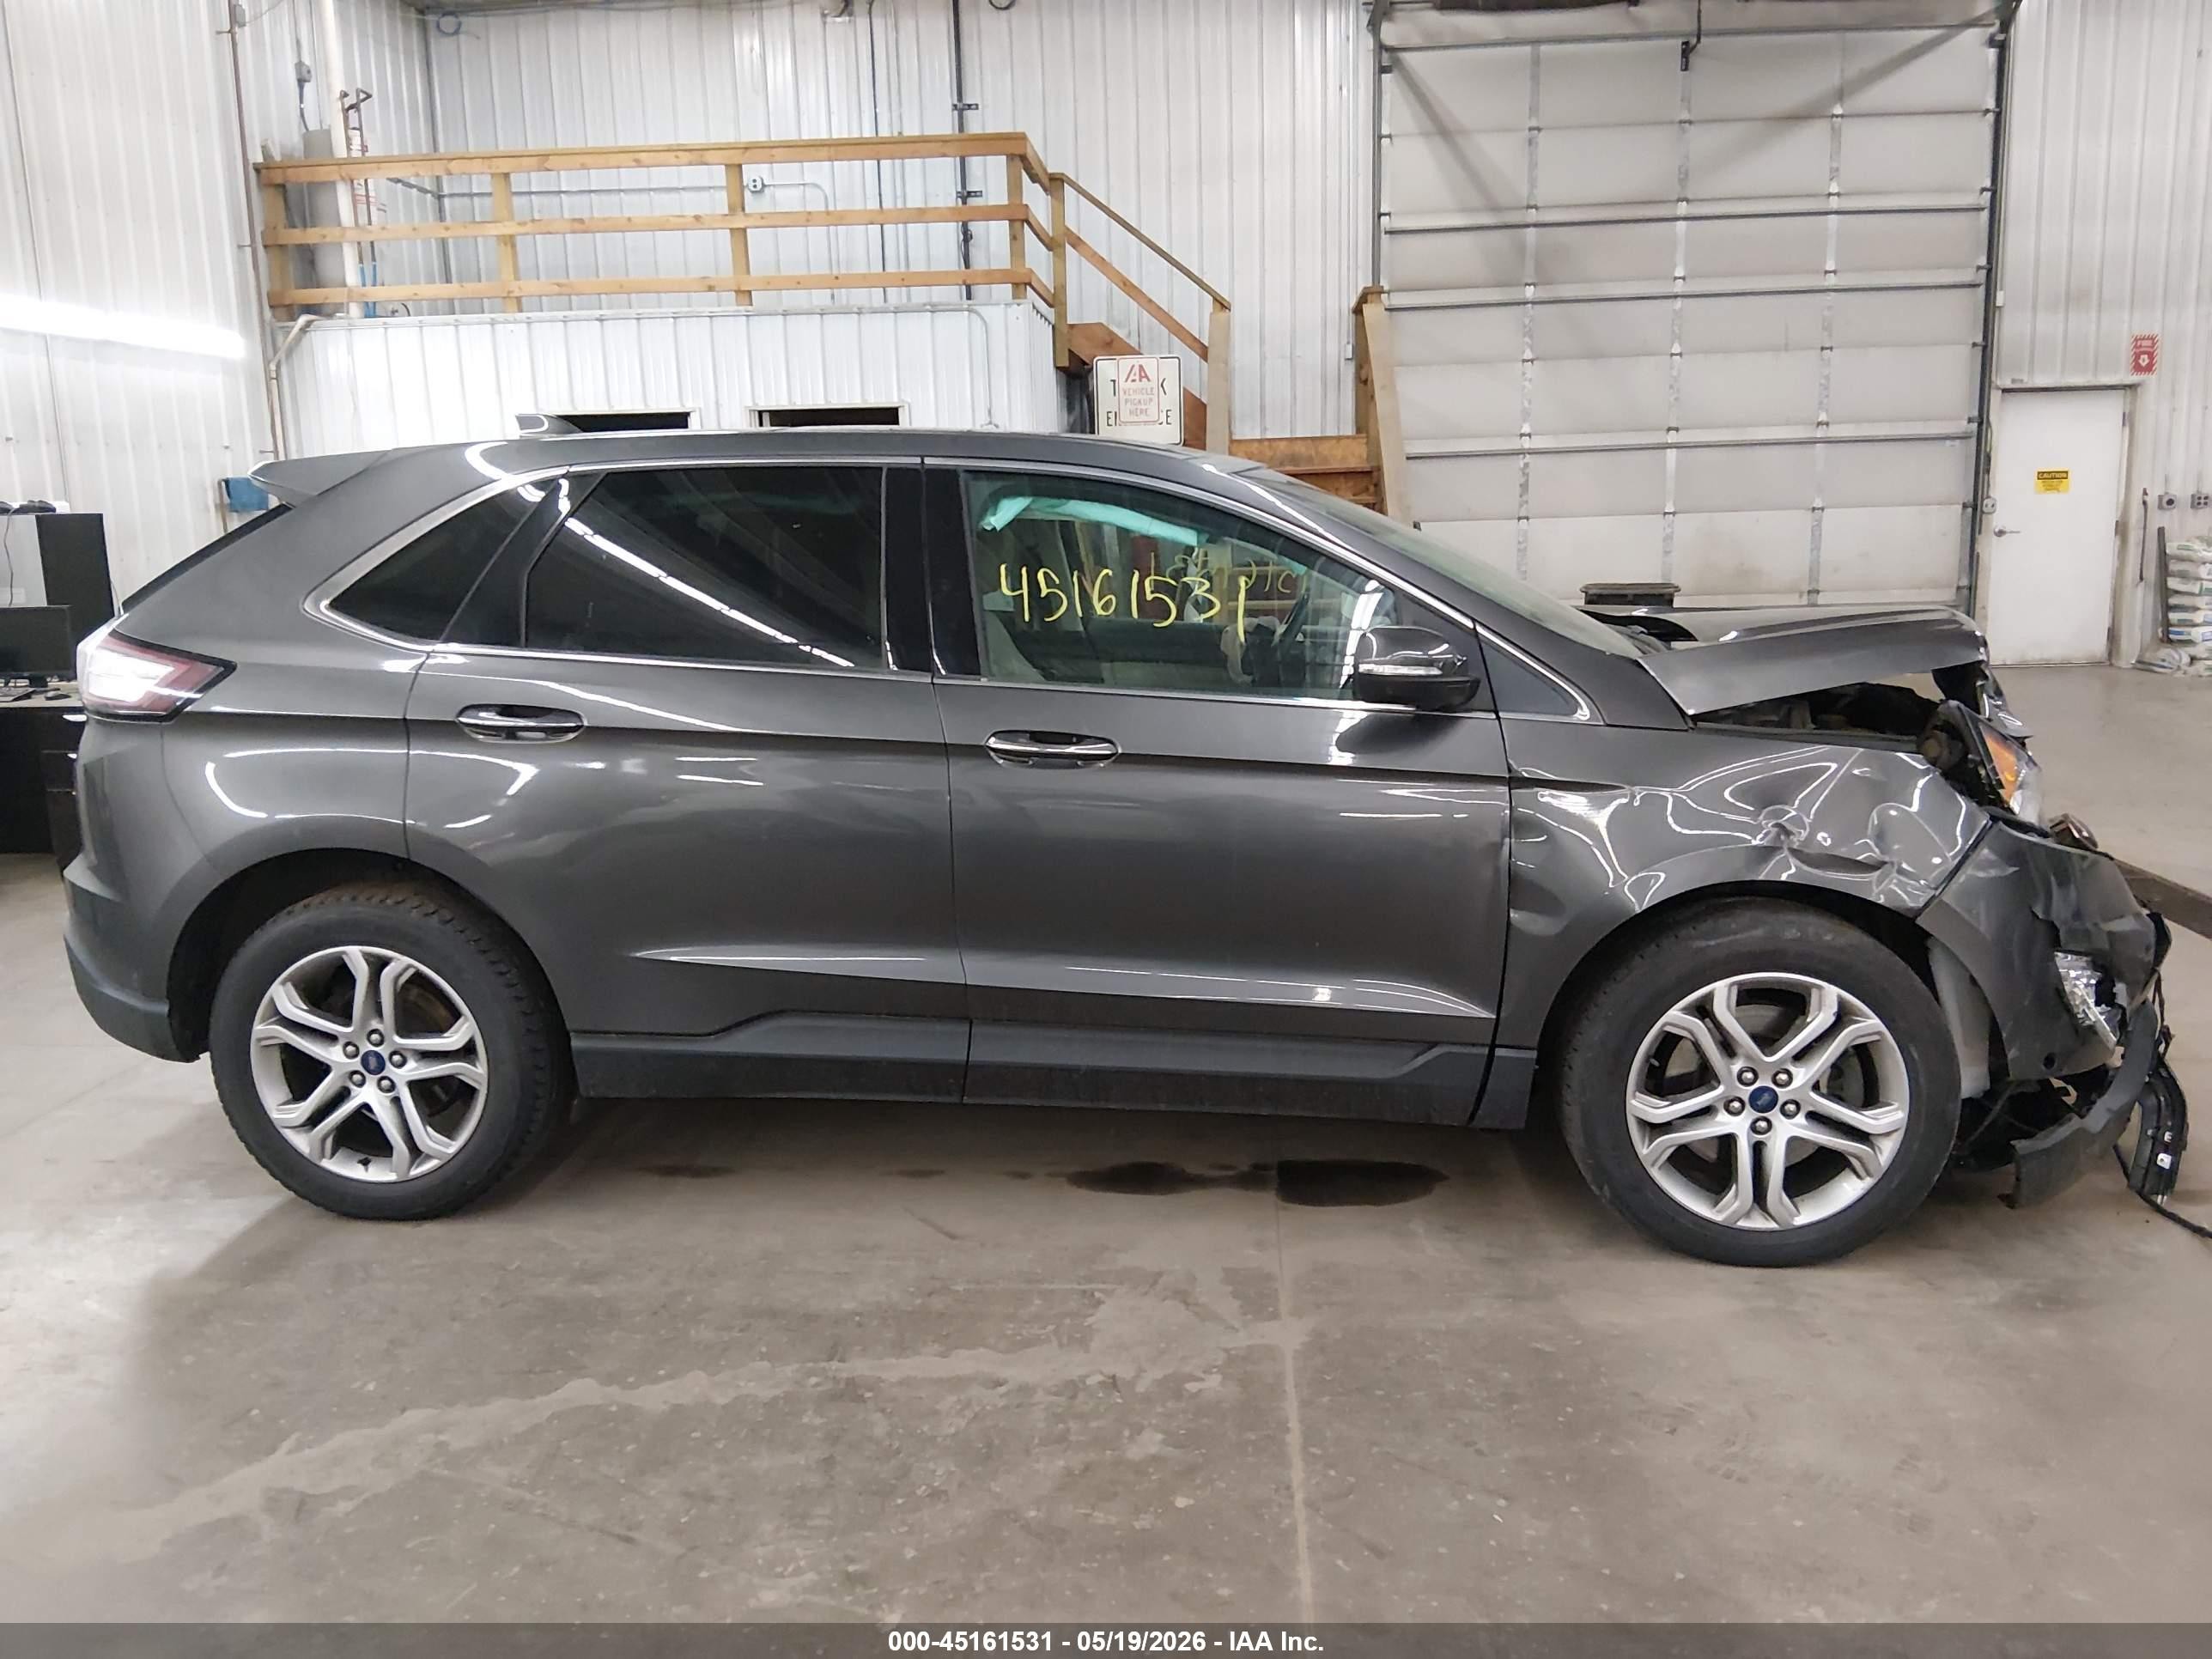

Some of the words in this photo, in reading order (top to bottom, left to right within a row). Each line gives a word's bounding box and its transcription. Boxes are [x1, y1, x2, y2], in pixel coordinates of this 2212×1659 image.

[1122, 386, 1155, 396] VEHICLE
[1125, 398, 1153, 406] PICKUP
[1129, 408, 1149, 417] HERE
[1000, 562, 1246, 646] 45161531
